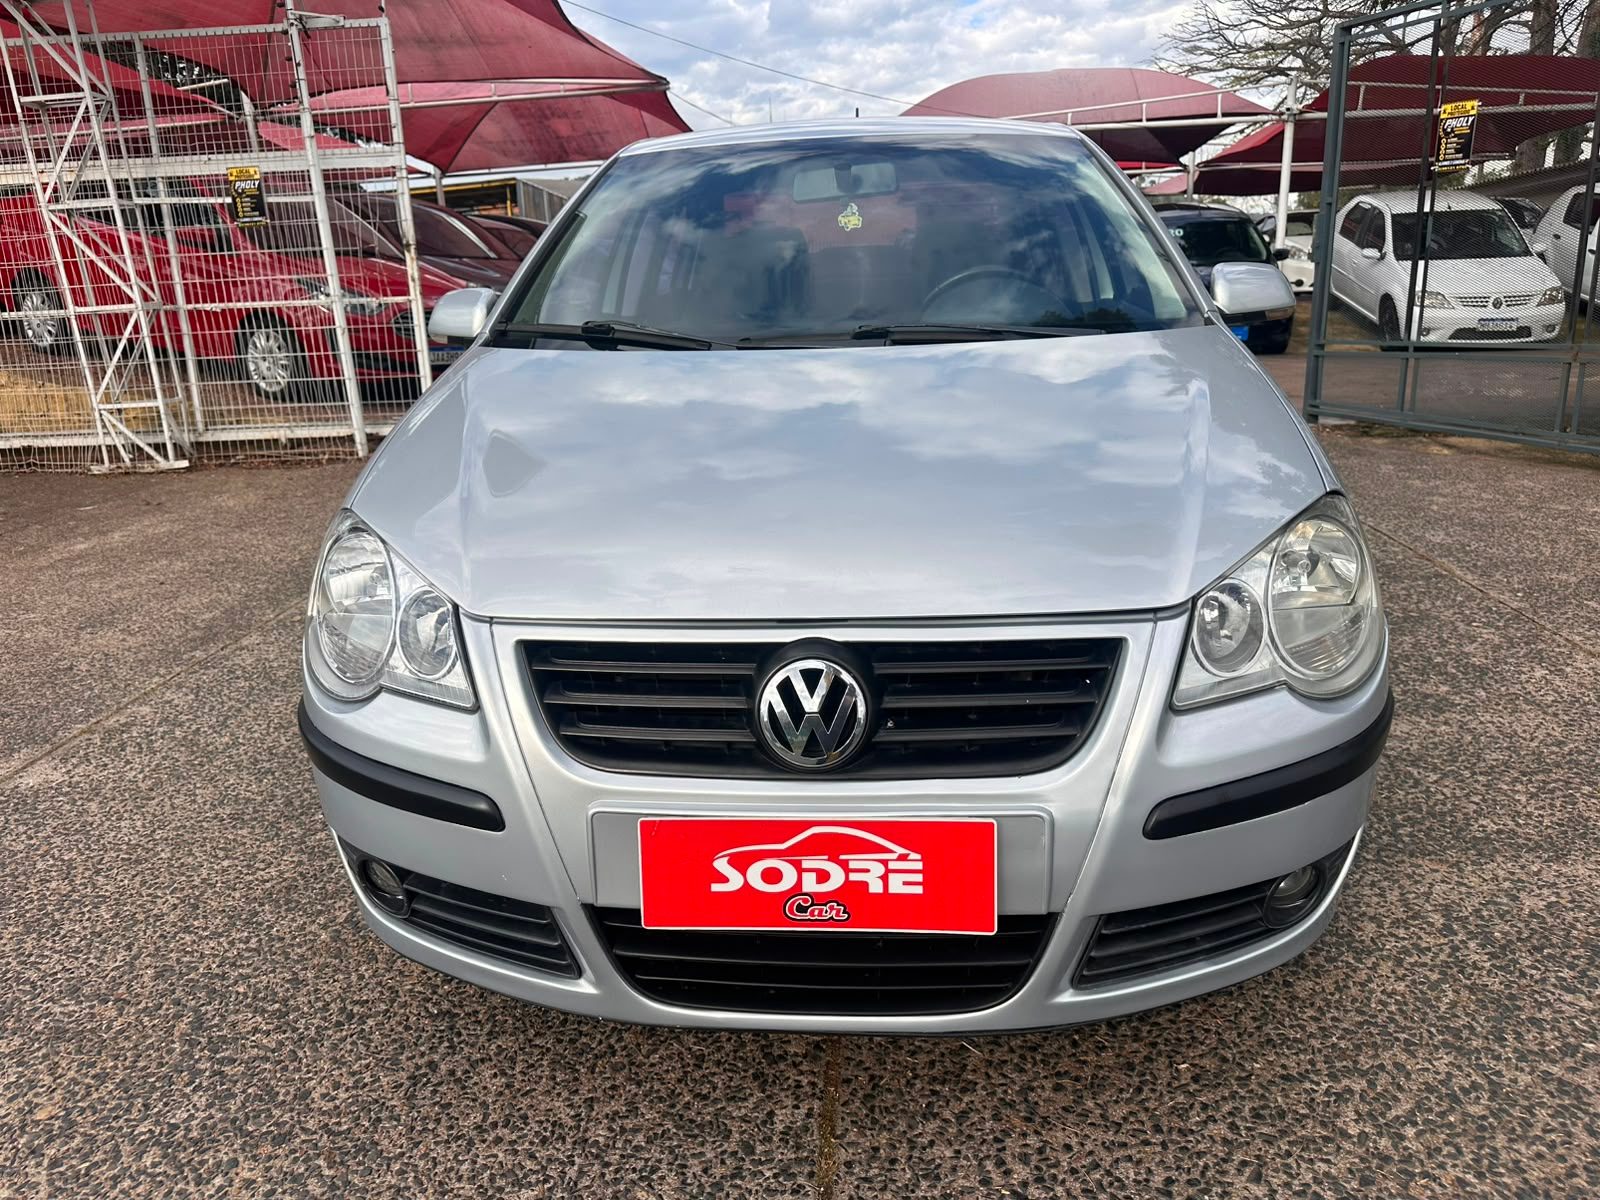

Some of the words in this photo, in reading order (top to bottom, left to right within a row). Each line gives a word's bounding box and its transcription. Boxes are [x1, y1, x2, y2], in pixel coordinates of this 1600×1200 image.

[1450, 103, 1468, 111] LOCAL
[1444, 116, 1475, 129] PHOLY
[235, 180, 260, 190] PHOLY
[762, 662, 863, 763] VW
[784, 894, 850, 922] Car
